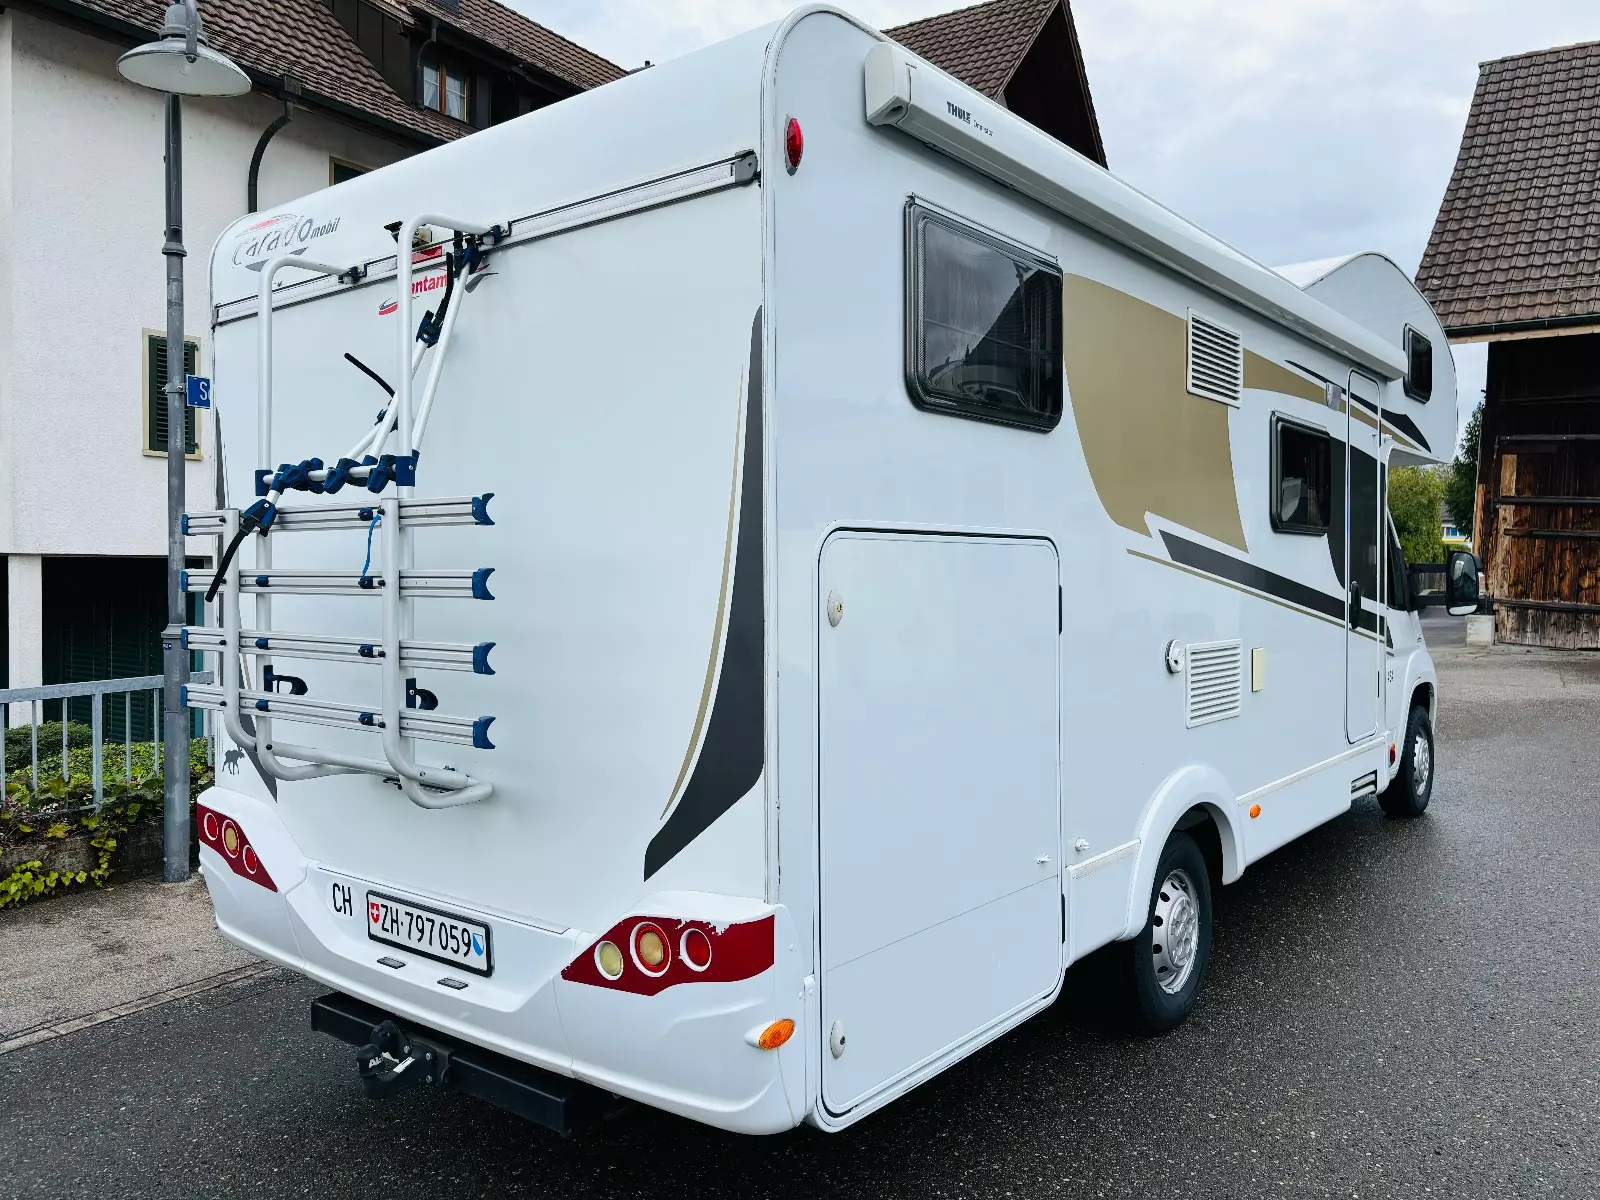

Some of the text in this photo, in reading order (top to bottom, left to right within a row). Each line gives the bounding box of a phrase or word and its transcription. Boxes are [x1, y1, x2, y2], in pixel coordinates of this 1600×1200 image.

[946, 101, 971, 123] THULE
[199, 380, 210, 401] S
[332, 883, 352, 916] CH
